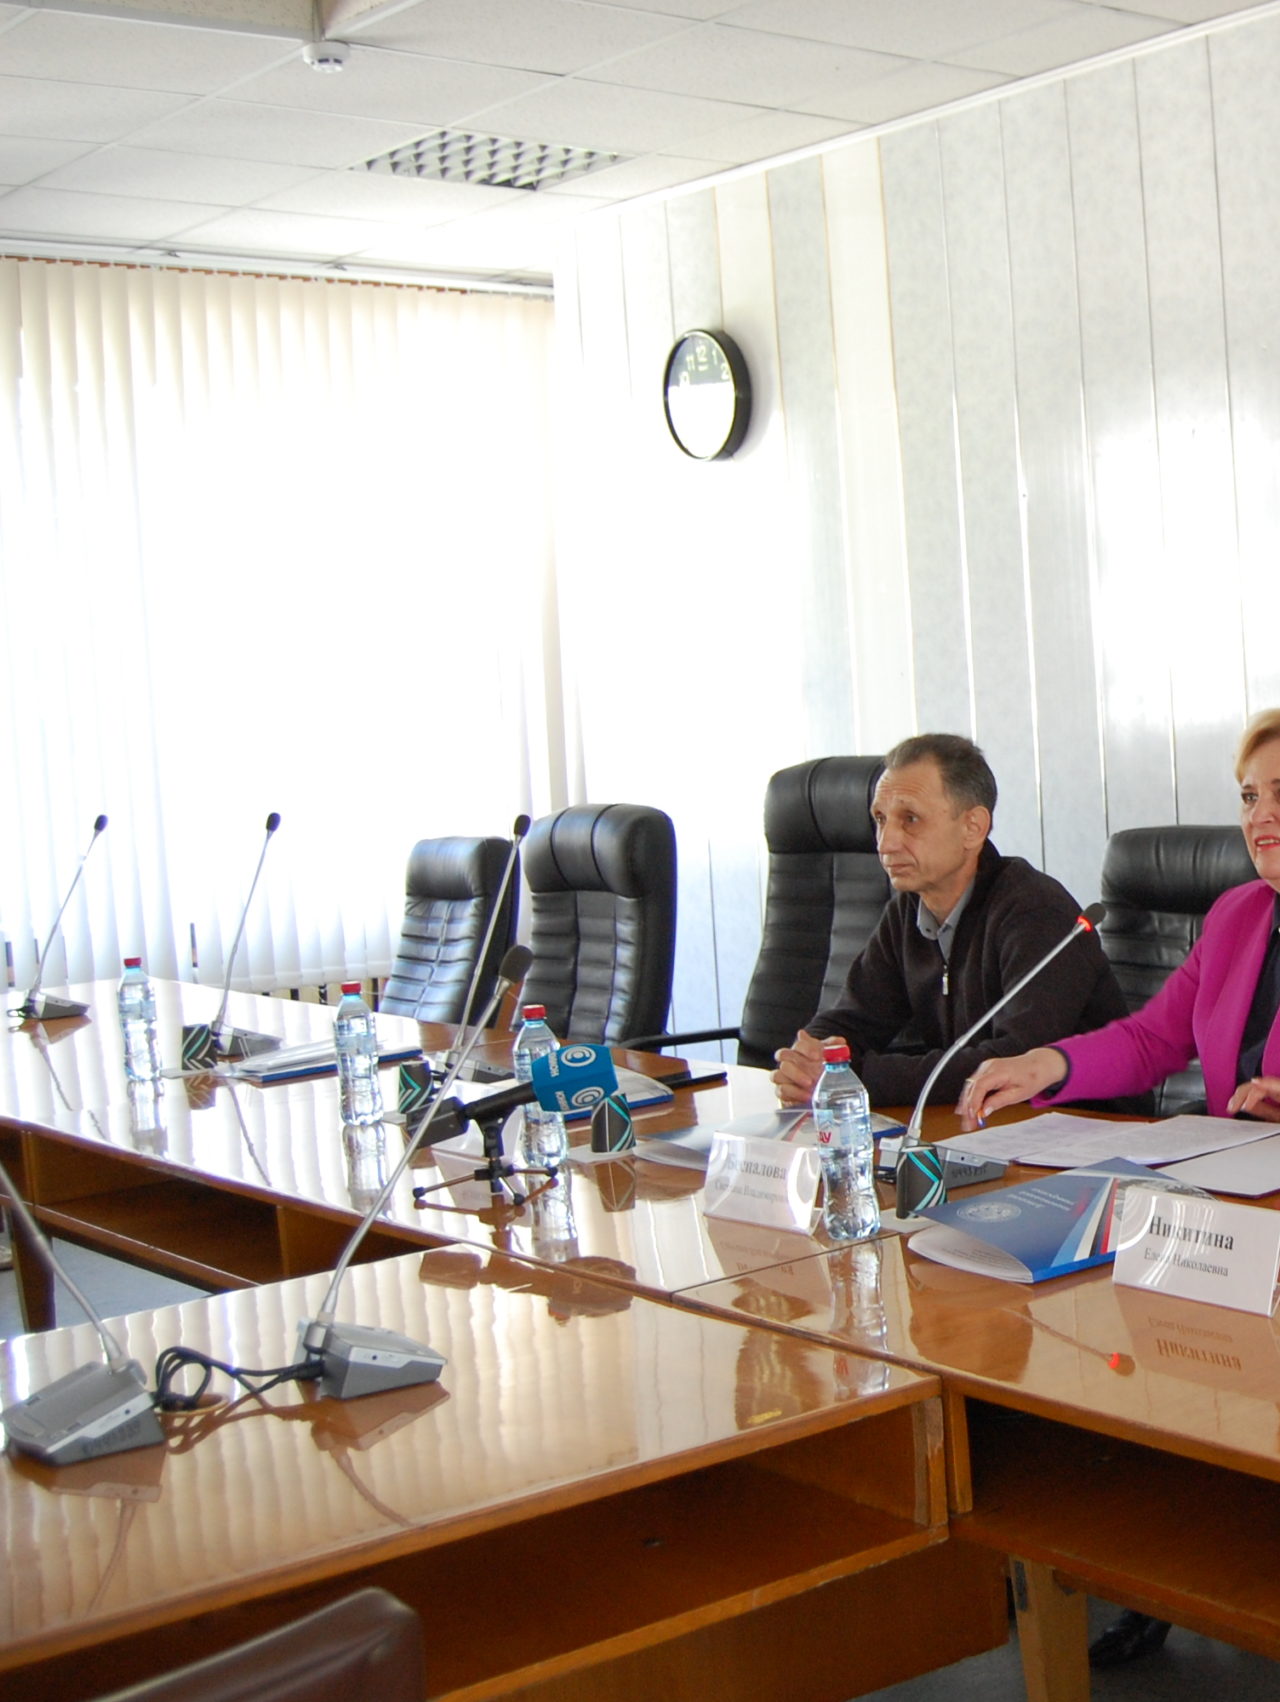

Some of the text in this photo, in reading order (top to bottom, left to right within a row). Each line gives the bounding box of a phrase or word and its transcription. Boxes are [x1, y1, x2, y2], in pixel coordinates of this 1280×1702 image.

[696, 345, 708, 362] 12
[686, 355, 695, 372] 11
[720, 363, 730, 380] 2
